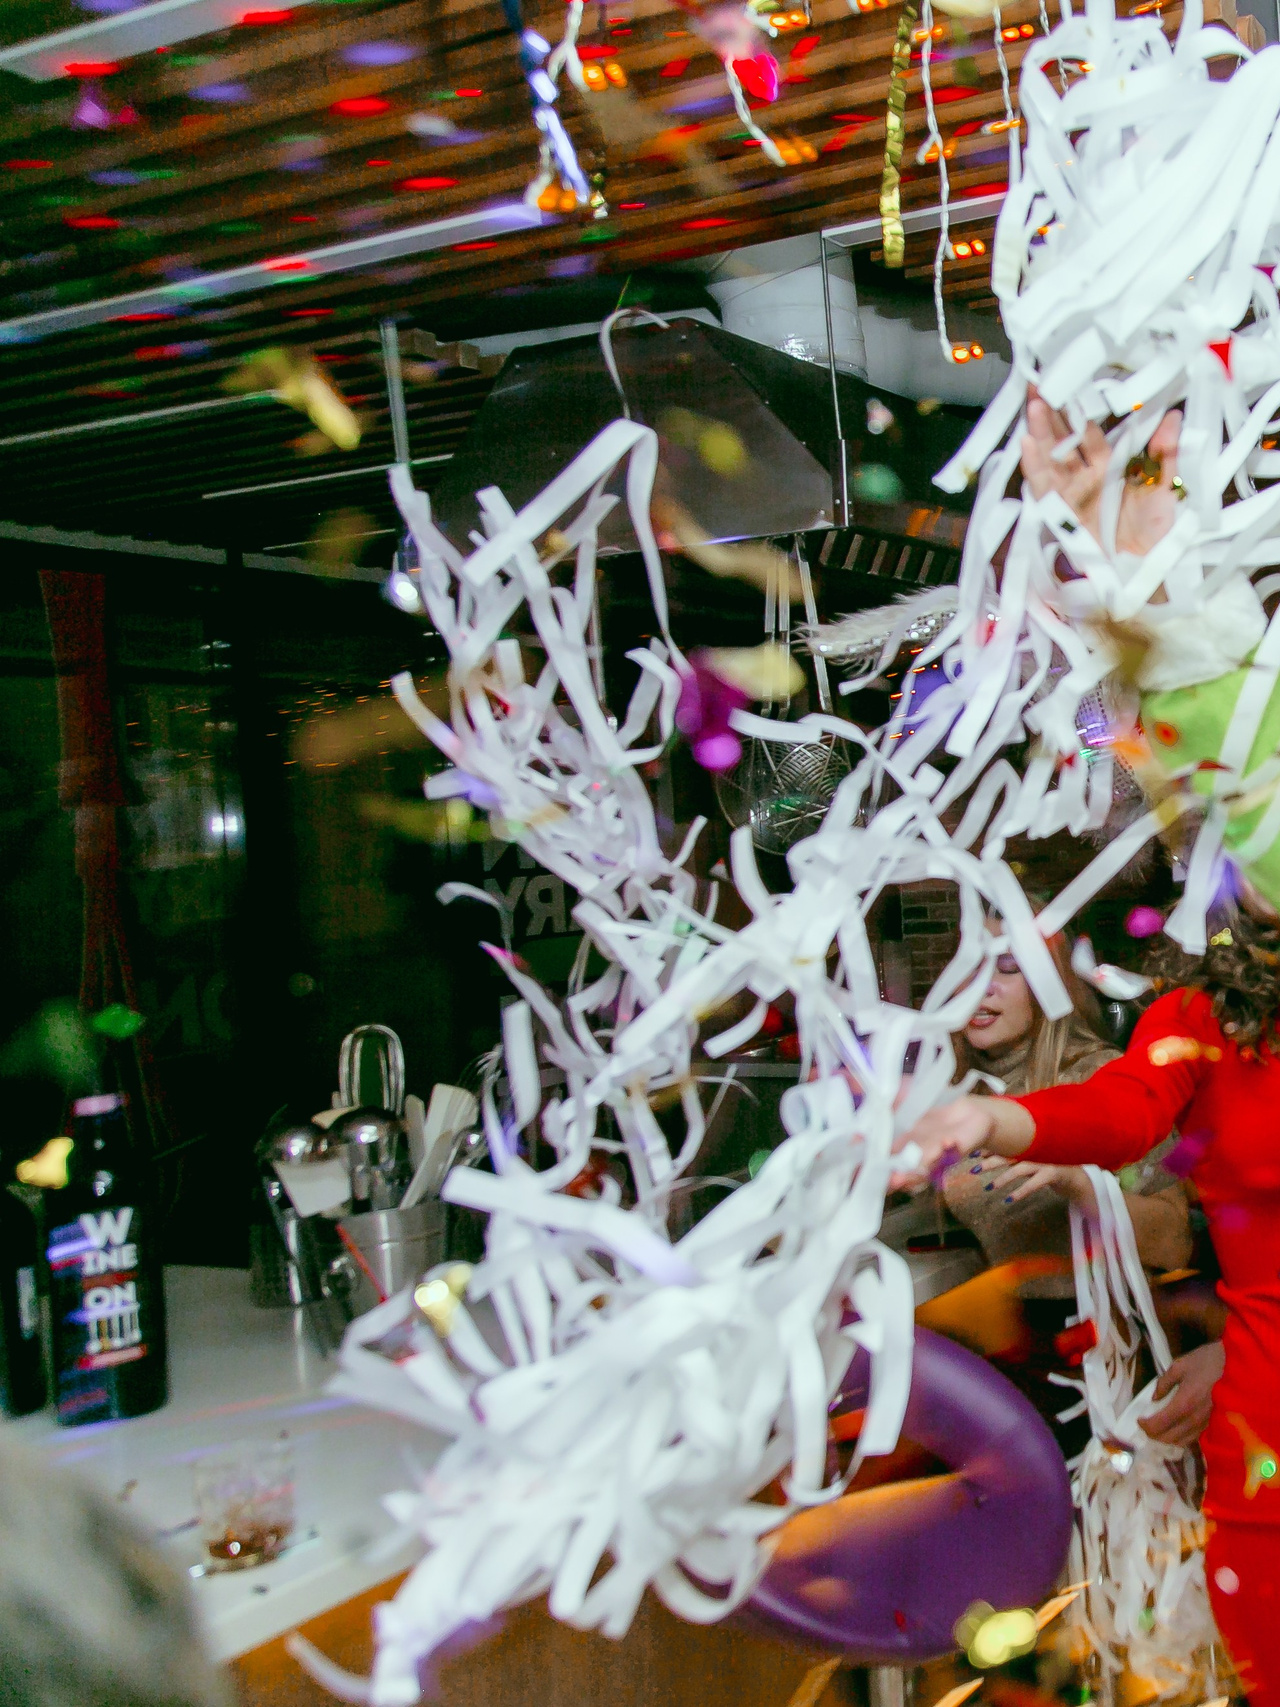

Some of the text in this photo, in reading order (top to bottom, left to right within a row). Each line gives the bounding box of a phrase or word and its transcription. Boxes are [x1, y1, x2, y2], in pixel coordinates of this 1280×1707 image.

[79, 1206, 134, 1248] W
[82, 1243, 138, 1277] INE
[84, 1281, 137, 1311] ON
